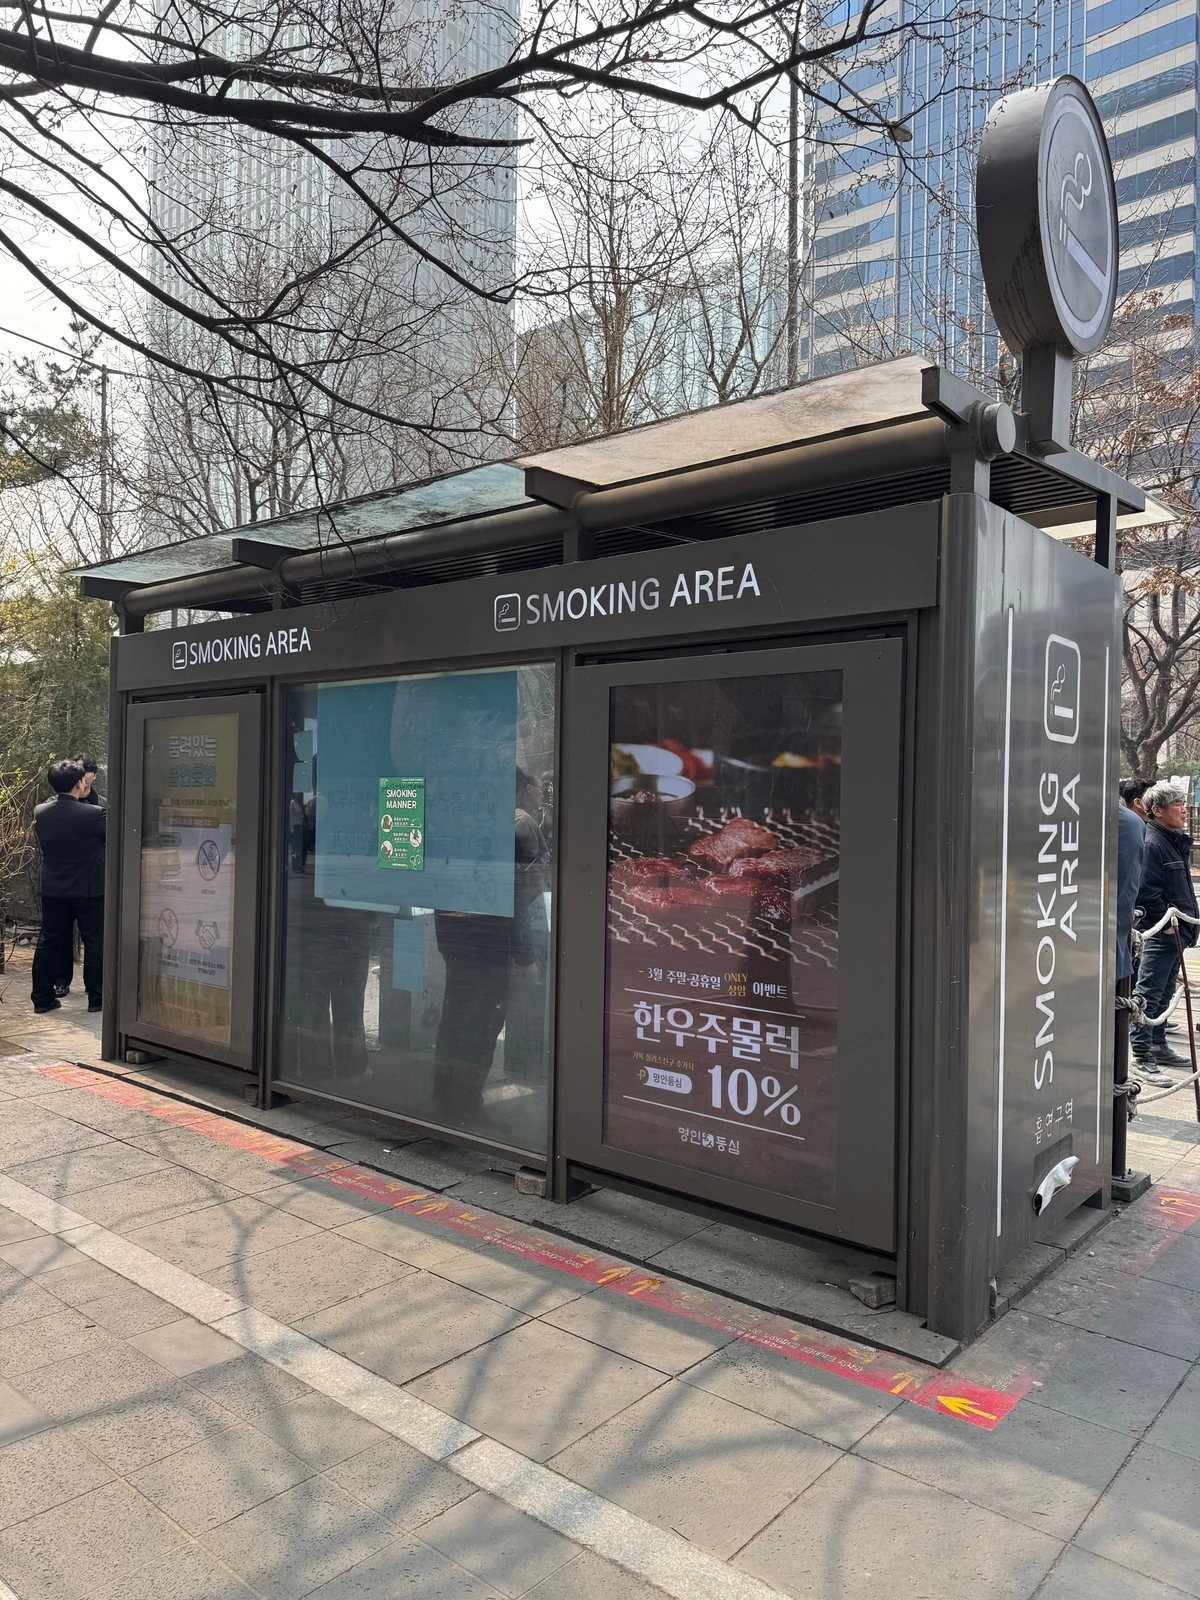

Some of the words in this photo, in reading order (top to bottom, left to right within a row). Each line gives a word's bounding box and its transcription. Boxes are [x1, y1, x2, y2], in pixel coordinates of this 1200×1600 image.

[526, 577, 660, 625] SMOKING
[669, 563, 762, 609] AREA
[188, 633, 261, 666] SMOKING
[266, 627, 312, 657] AREA
[168, 734, 218, 759] 품격있는
[167, 762, 217, 788] 흡연문화
[386, 789, 417, 799] SMOKING
[386, 800, 417, 810] MANNER
[1058, 772, 1082, 943] AREA
[1033, 771, 1060, 1092] SMOKING
[646, 967, 663, 982] 3월
[724, 972, 749, 984] ONLY
[728, 984, 747, 997] 상암
[752, 981, 788, 999] 이벤트
[633, 1000, 800, 1070] 한우주물럭
[676, 1060, 695, 1071] 추가시
[652, 1072, 683, 1089] 명인등심
[707, 1064, 801, 1126] 10%
[1034, 1097, 1075, 1146] 흡연구역
